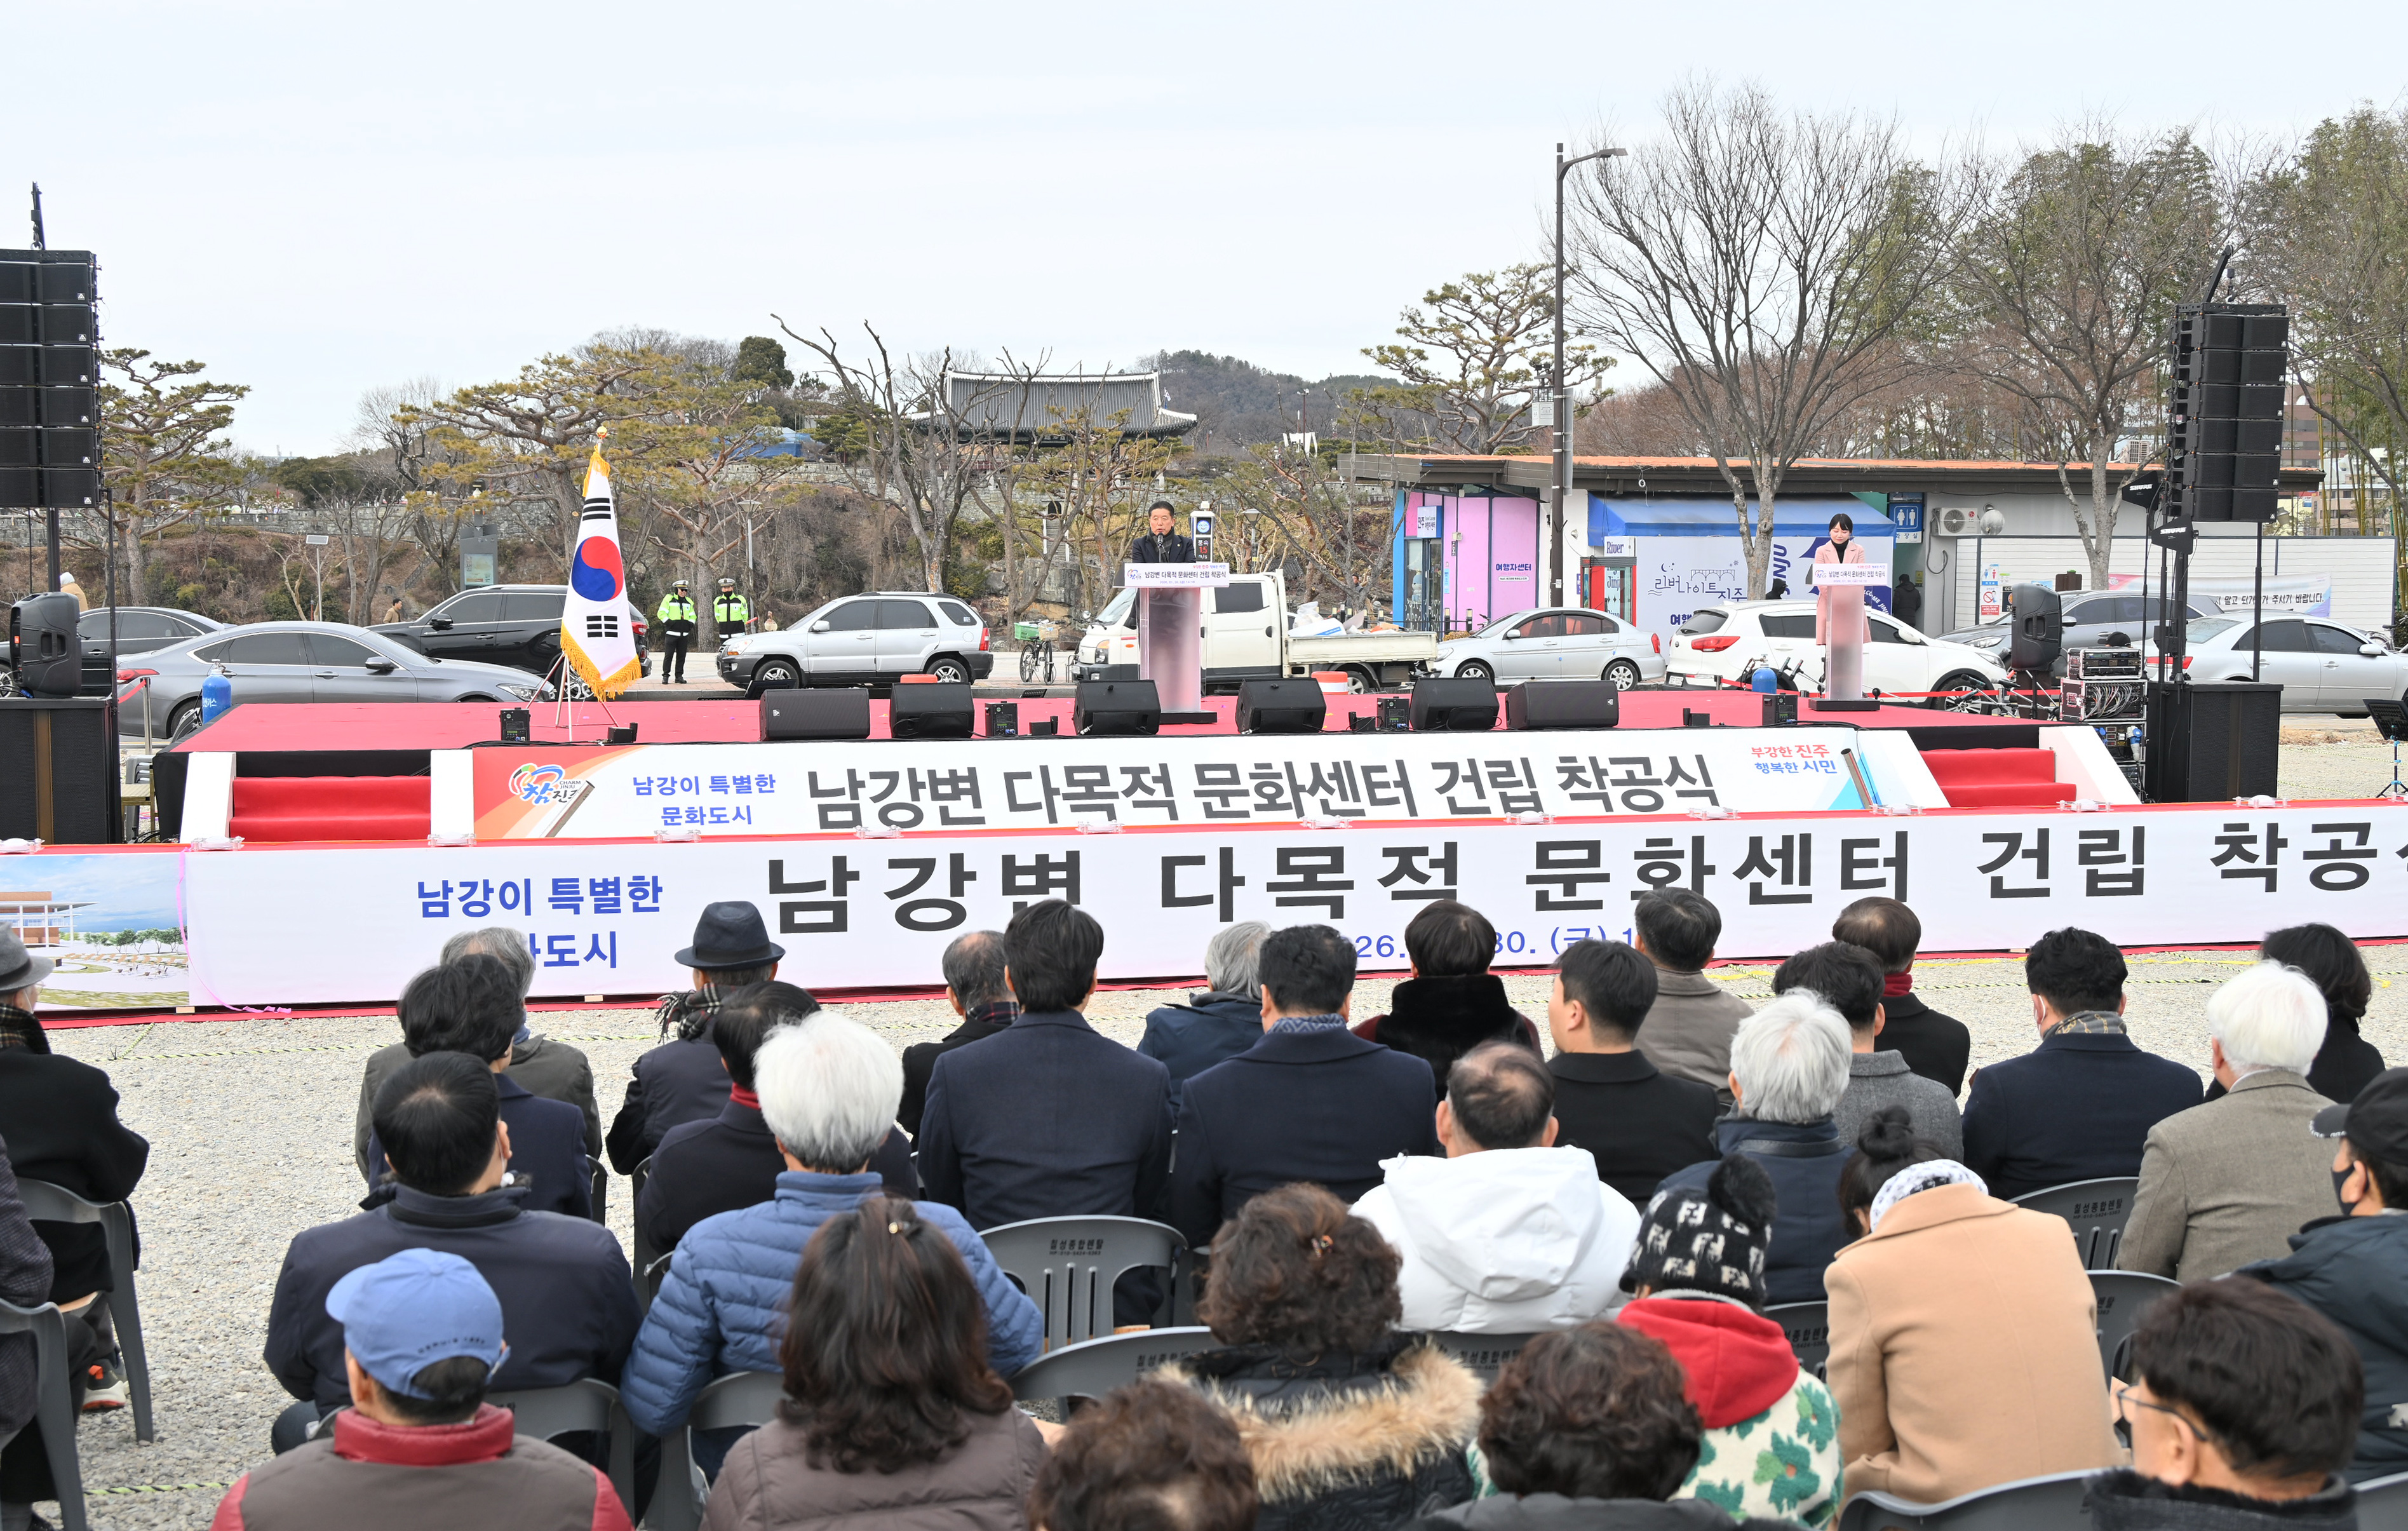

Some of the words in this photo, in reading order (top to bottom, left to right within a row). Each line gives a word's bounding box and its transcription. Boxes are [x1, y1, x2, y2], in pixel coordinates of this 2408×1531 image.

[1418, 517, 1425, 529] 진주
[1606, 541, 1624, 554] River
[1211, 570, 1227, 579] 착공식
[1607, 576, 1620, 591] Jinj
[2224, 595, 2238, 605] 말고
[2271, 593, 2292, 605] 주시기
[2295, 592, 2324, 604] 바랍니다.
[1751, 746, 1793, 759] 부강한
[1794, 745, 1830, 759] 진주
[1754, 762, 1799, 774] 행복한
[1803, 760, 1838, 774] 시민
[522, 782, 554, 804] 참
[633, 776, 701, 797] 남강이
[708, 773, 776, 795] 특별한
[808, 767, 986, 830] 남강변
[1003, 762, 1179, 824] 다목적
[1194, 759, 1418, 819] 문화센터
[1434, 757, 1545, 815] 건립
[1557, 753, 1719, 813] 착공식
[661, 804, 753, 826] 문화도시
[769, 850, 1080, 934] 남강변
[1161, 842, 1457, 922] 다목적
[1526, 830, 1909, 912] 문화센터
[1977, 825, 2146, 900] 건립
[2210, 821, 2408, 893] 착공
[417, 877, 533, 919] 남강이
[548, 875, 664, 915] 특별한
[529, 931, 617, 970] 도시
